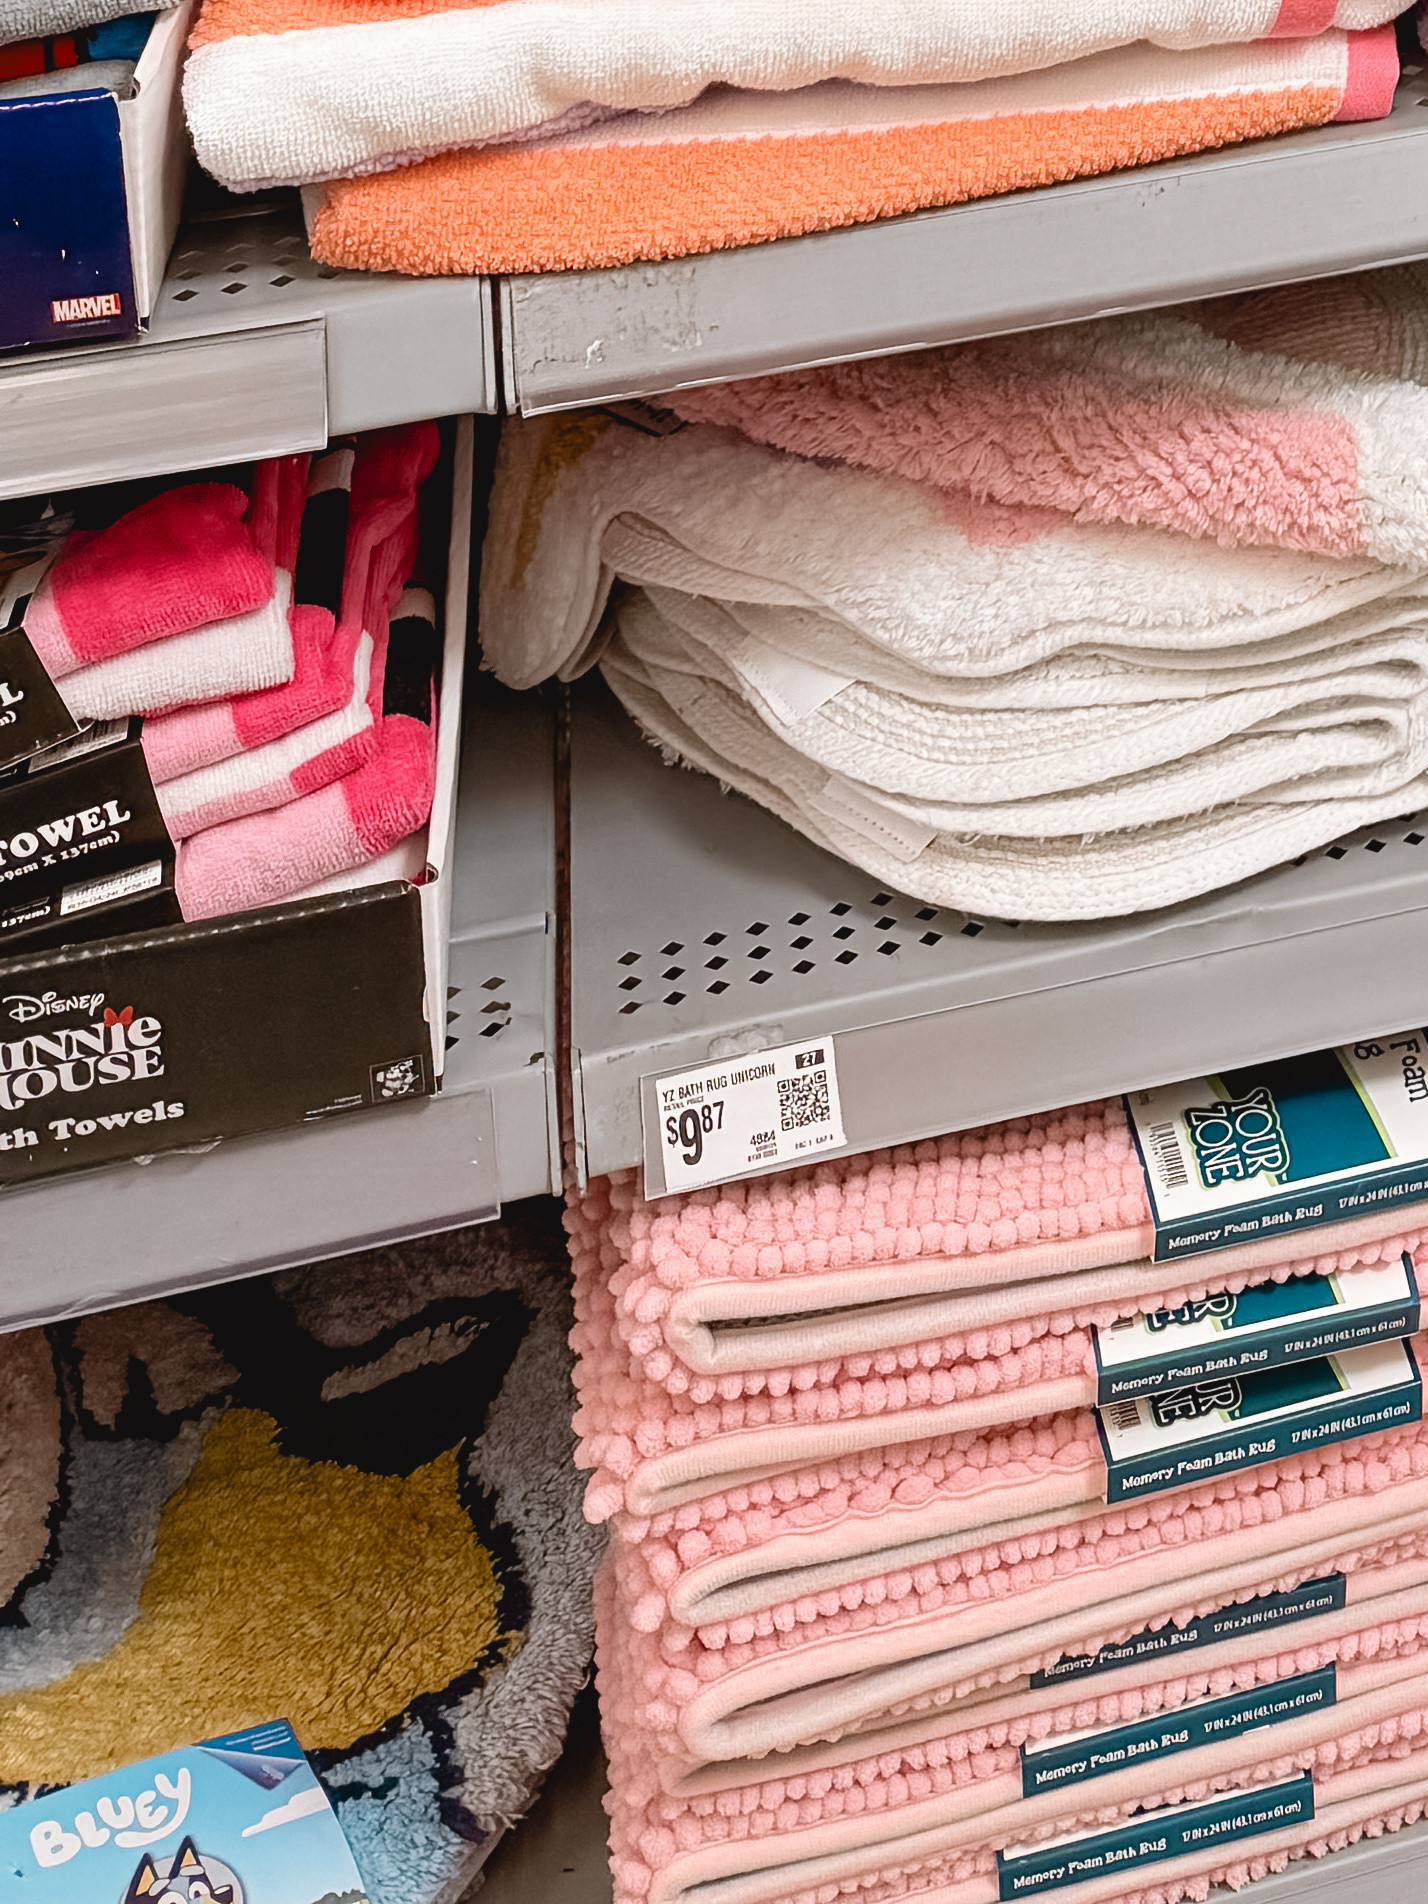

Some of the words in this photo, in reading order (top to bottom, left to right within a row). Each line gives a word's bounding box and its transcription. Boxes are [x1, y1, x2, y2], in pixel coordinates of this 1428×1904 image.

[53, 294, 121, 322] MARVEL
[662, 1087, 677, 1102] YZ
[679, 1077, 704, 1099] BATH
[706, 1073, 727, 1093] RUG
[731, 1063, 776, 1085] UNICORN
[801, 1051, 819, 1066] 27
[49, 1098, 185, 1142] Towels
[30, 1767, 192, 1868] BLUEY
